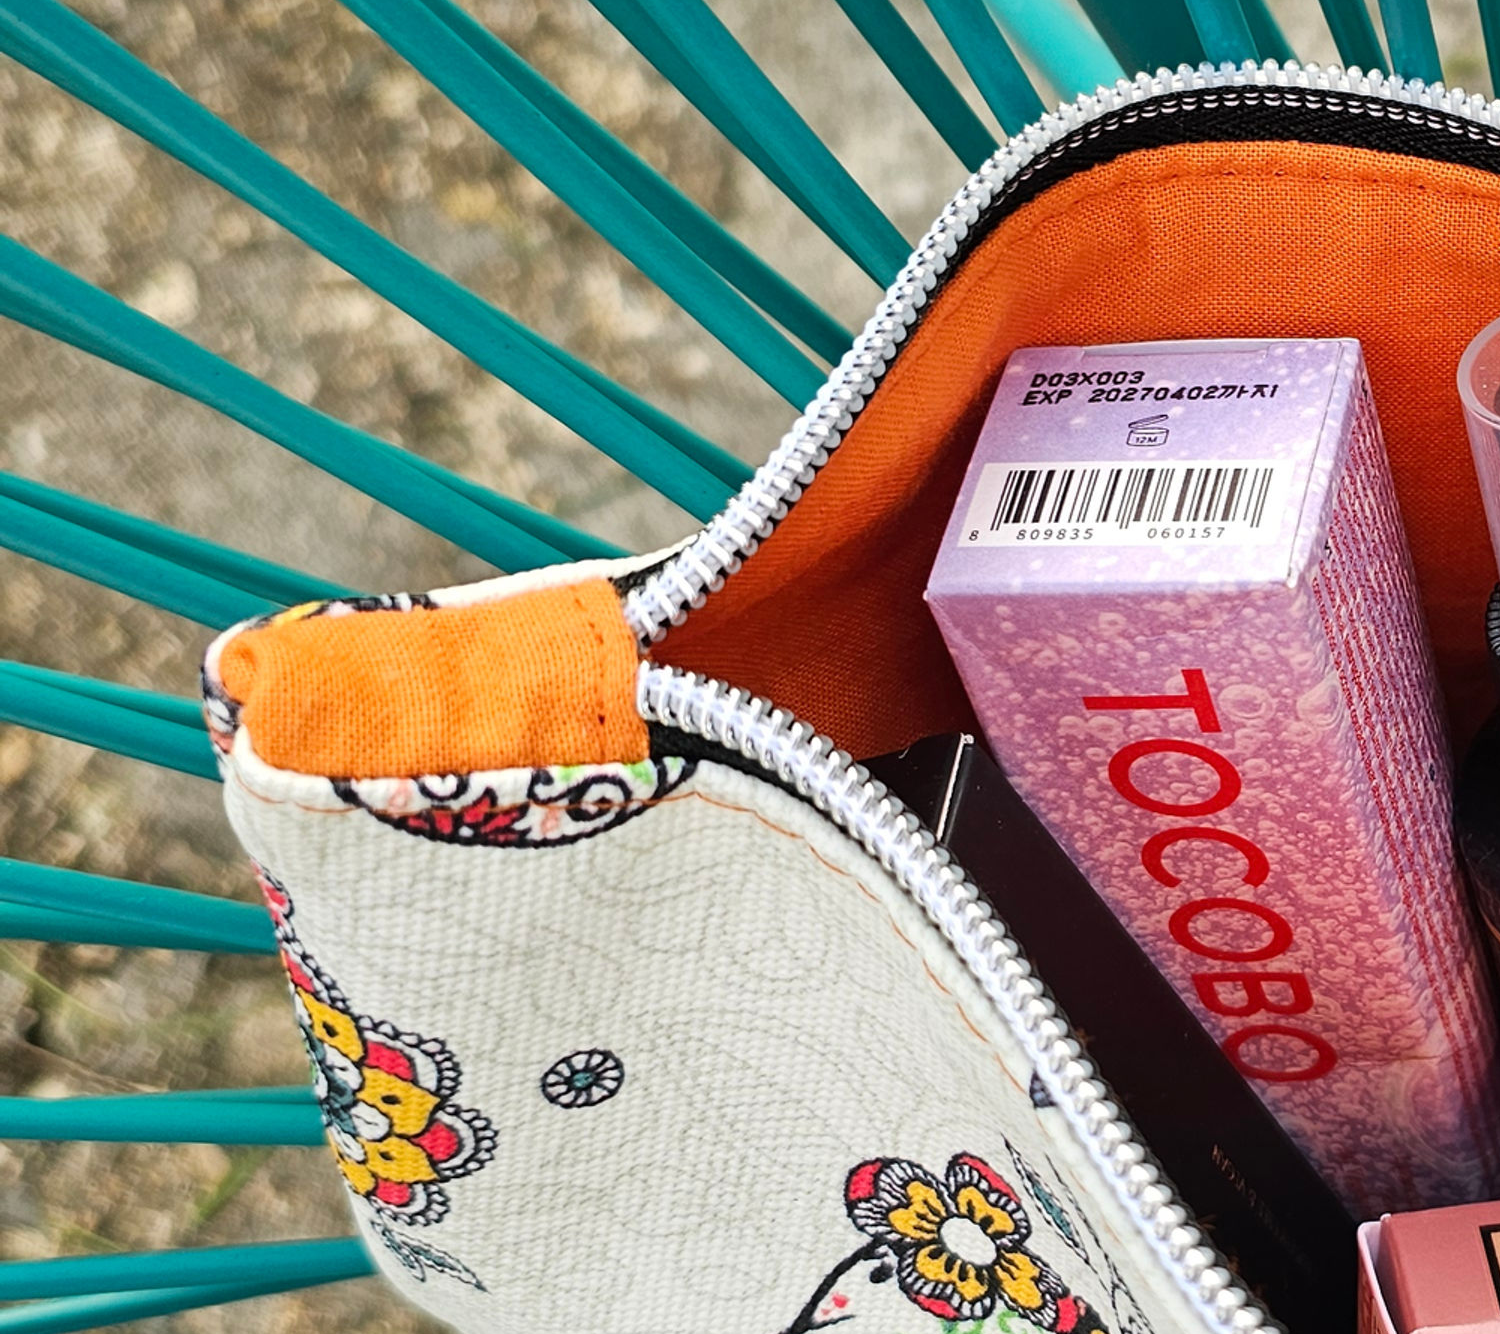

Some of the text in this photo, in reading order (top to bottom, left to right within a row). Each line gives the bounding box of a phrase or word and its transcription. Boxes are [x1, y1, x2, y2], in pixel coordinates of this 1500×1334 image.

[1030, 371, 1145, 388] D03X003
[1021, 389, 1073, 407] EXP
[968, 526, 1226, 542] 8 809835 060157
[1081, 668, 1338, 1083] TOCOBO
